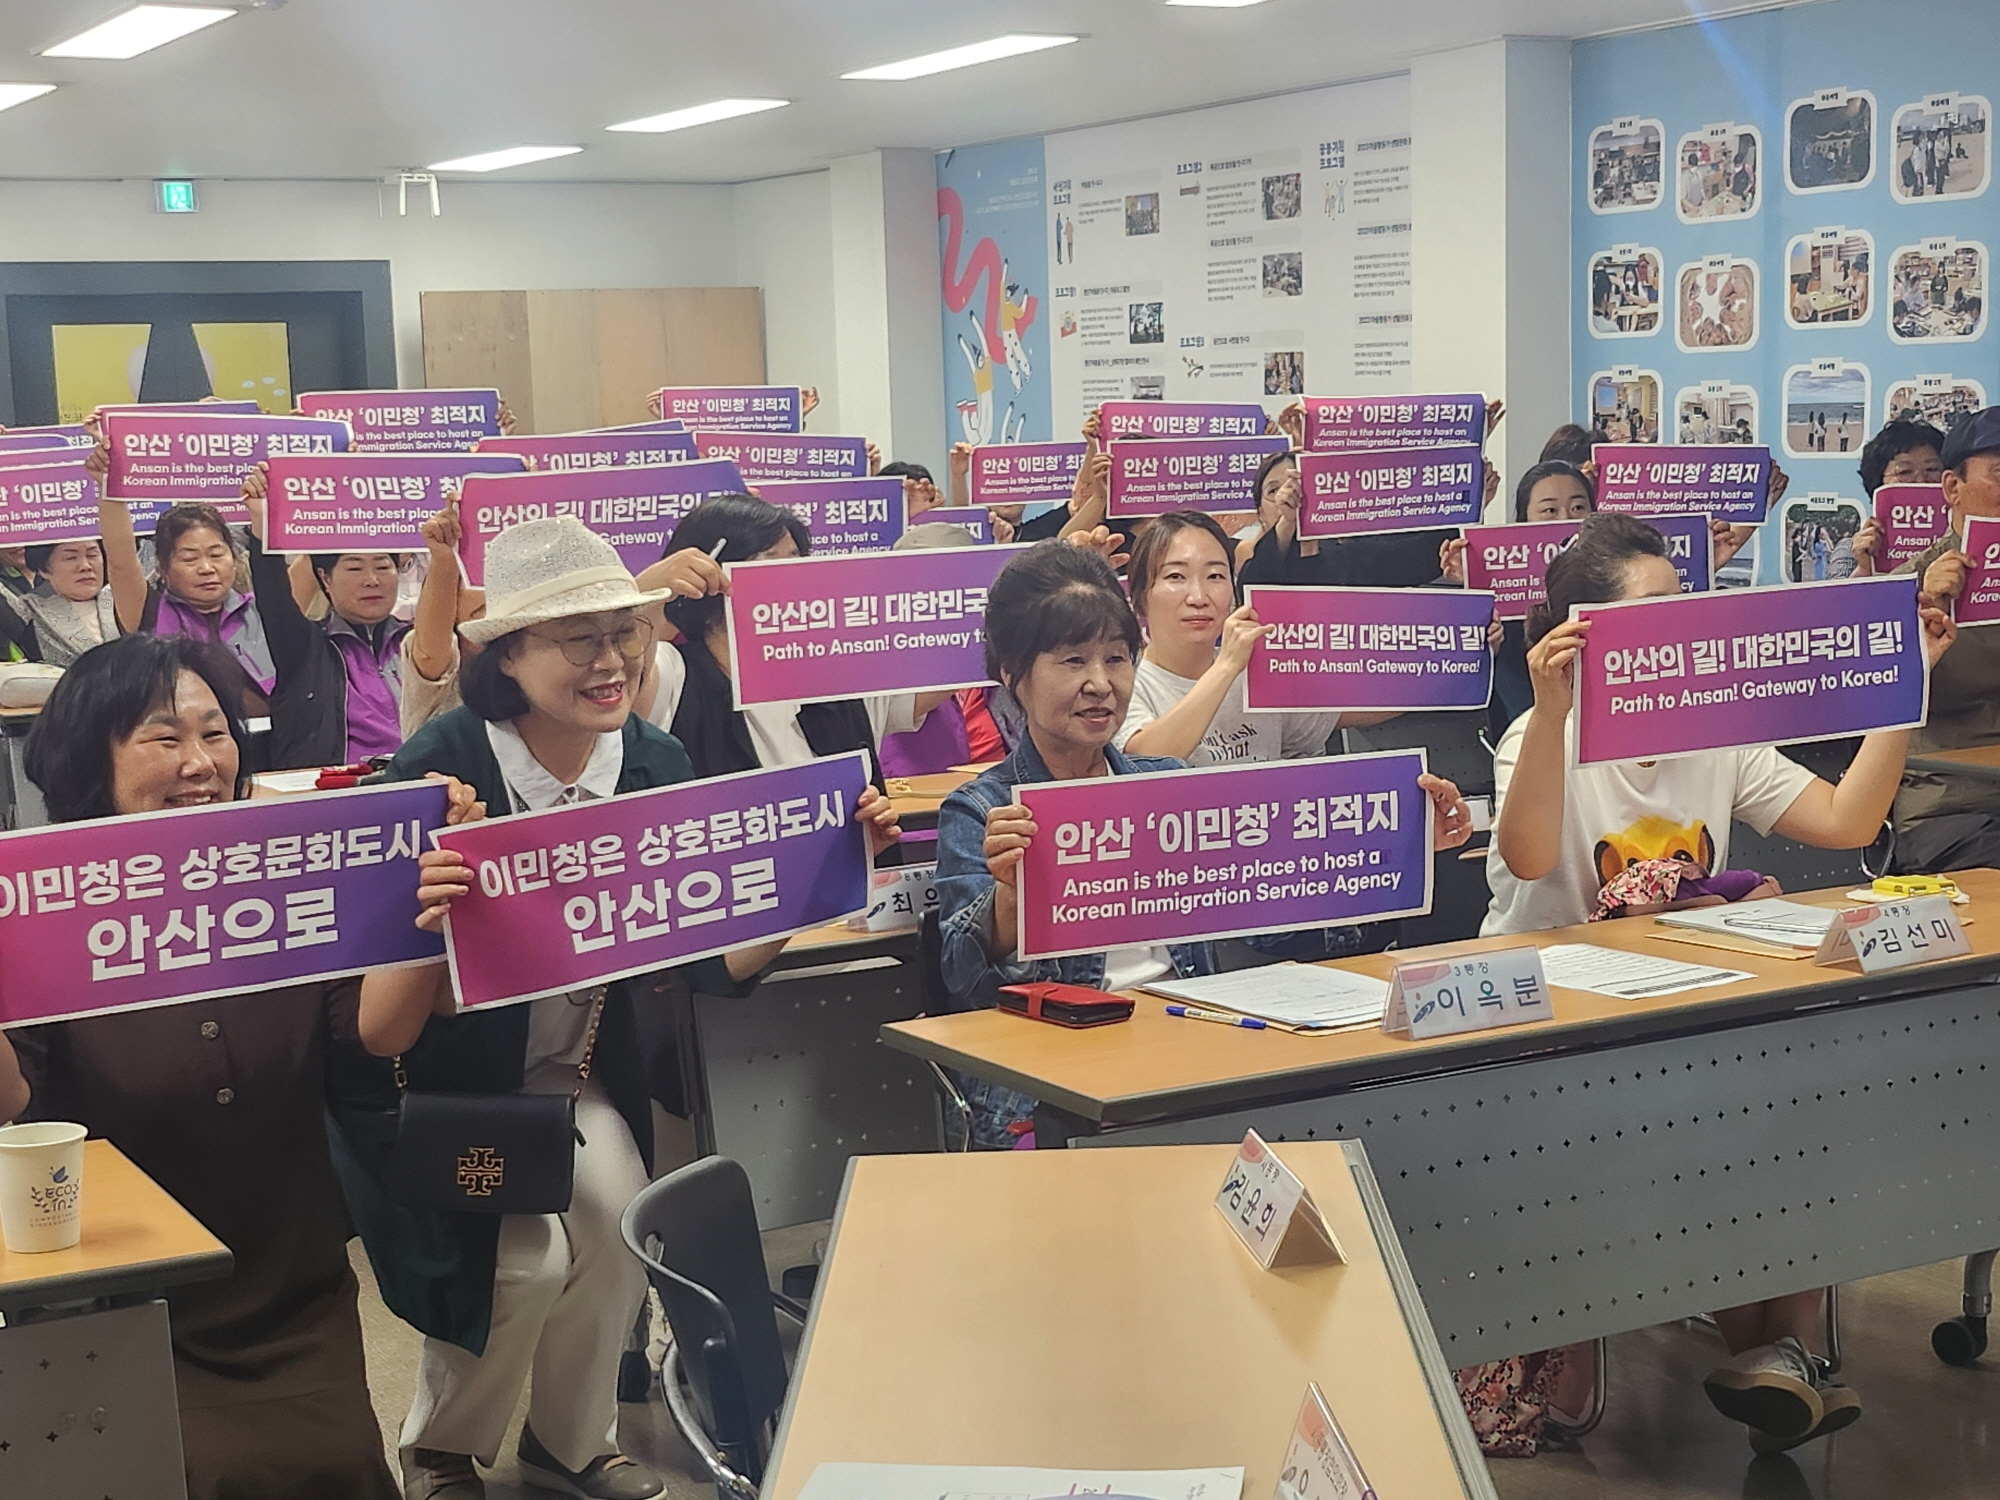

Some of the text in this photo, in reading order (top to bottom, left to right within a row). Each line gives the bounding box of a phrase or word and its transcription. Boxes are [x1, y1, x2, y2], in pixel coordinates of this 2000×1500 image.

[358, 406, 425, 427] ‘이민청’
[430, 404, 487, 425] 최적지
[672, 397, 791, 414] 안산 ‘이민청’ 최적지
[1318, 404, 1473, 424] 안산 ‘이민청’ 최적지
[366, 432, 381, 440] the
[1111, 415, 1257, 435] 안산 ‘이민청’ 최적지
[124, 432, 334, 457] 안산 ‘이민청’ 최적지
[745, 446, 856, 466] ‘이민청’ 최적지
[130, 462, 234, 474] Ansan is the best
[982, 458, 1011, 475] 안산
[1123, 453, 1262, 478] 안산 ‘이민청’ 최적
[1605, 462, 1760, 484] 안산 ‘이민청’ 최적지
[122, 474, 243, 488] Korean Immigration
[284, 475, 431, 501] 안산 ‘이민청’
[1315, 463, 1473, 495] 안산 ‘이민청’ 최적지
[13, 479, 88, 504] ‘이민청’
[1317, 501, 1347, 510] Ansan
[1349, 498, 1357, 508] is
[1358, 498, 1373, 508] the
[1375, 496, 1395, 506] best
[1398, 494, 1422, 506] place
[1424, 494, 1433, 502] to
[1435, 492, 1455, 501] host
[1606, 490, 1635, 499] Ansan
[1637, 490, 1644, 499] is
[1646, 490, 1660, 499] the
[1663, 490, 1683, 499] best
[1710, 490, 1719, 499] to
[1721, 490, 1740, 499] host
[1742, 491, 1753, 499] an
[11, 510, 21, 520] is
[22, 508, 41, 520] the
[42, 504, 67, 518] best
[293, 509, 336, 520] Ansan
[338, 509, 349, 520] is
[352, 508, 375, 520] the
[378, 508, 406, 520] best
[590, 492, 702, 525] 대한민국의
[824, 498, 889, 526] 최적지
[1311, 503, 1472, 523] Korean Immigration Service Agency
[1597, 502, 1631, 511] Korean
[1688, 502, 1721, 511] Service
[1891, 505, 1935, 529] 안산
[10, 517, 77, 532] Immigration
[285, 522, 416, 536] Korean Immigration
[830, 532, 879, 544] to host a
[1893, 535, 1931, 546] Ansan
[1483, 544, 1530, 571] 안산
[1489, 574, 1540, 589] Ansan is
[752, 587, 989, 635] 안산의 길! 대한민국
[763, 630, 971, 661] Path to Ansan! Gateway
[1265, 623, 1486, 651] 안산의 길! 대한민국의 길!
[1604, 621, 1904, 686] 안산의 길! 대한민국의 길!
[1269, 658, 1480, 677] Path to Ansan! Gateway to Korea!
[1610, 665, 1900, 716] Path to Ansan! Gateway to Korea!
[1054, 789, 1400, 866] 안산 ‘이민청’ 최적지
[478, 790, 846, 899] 이민청은 상호문화도시
[0, 818, 421, 918] 이민청은 상호문화도시
[1063, 849, 1381, 899] Ansan is the best place to host a
[564, 857, 780, 955] 안산으로
[1052, 869, 1402, 924] Korean Immigration Service Agency
[86, 887, 340, 983] 안산으로
[1878, 918, 1957, 954] 김선미
[1437, 974, 1542, 1017] 이옥분
[45, 1184, 73, 1199] ECO
